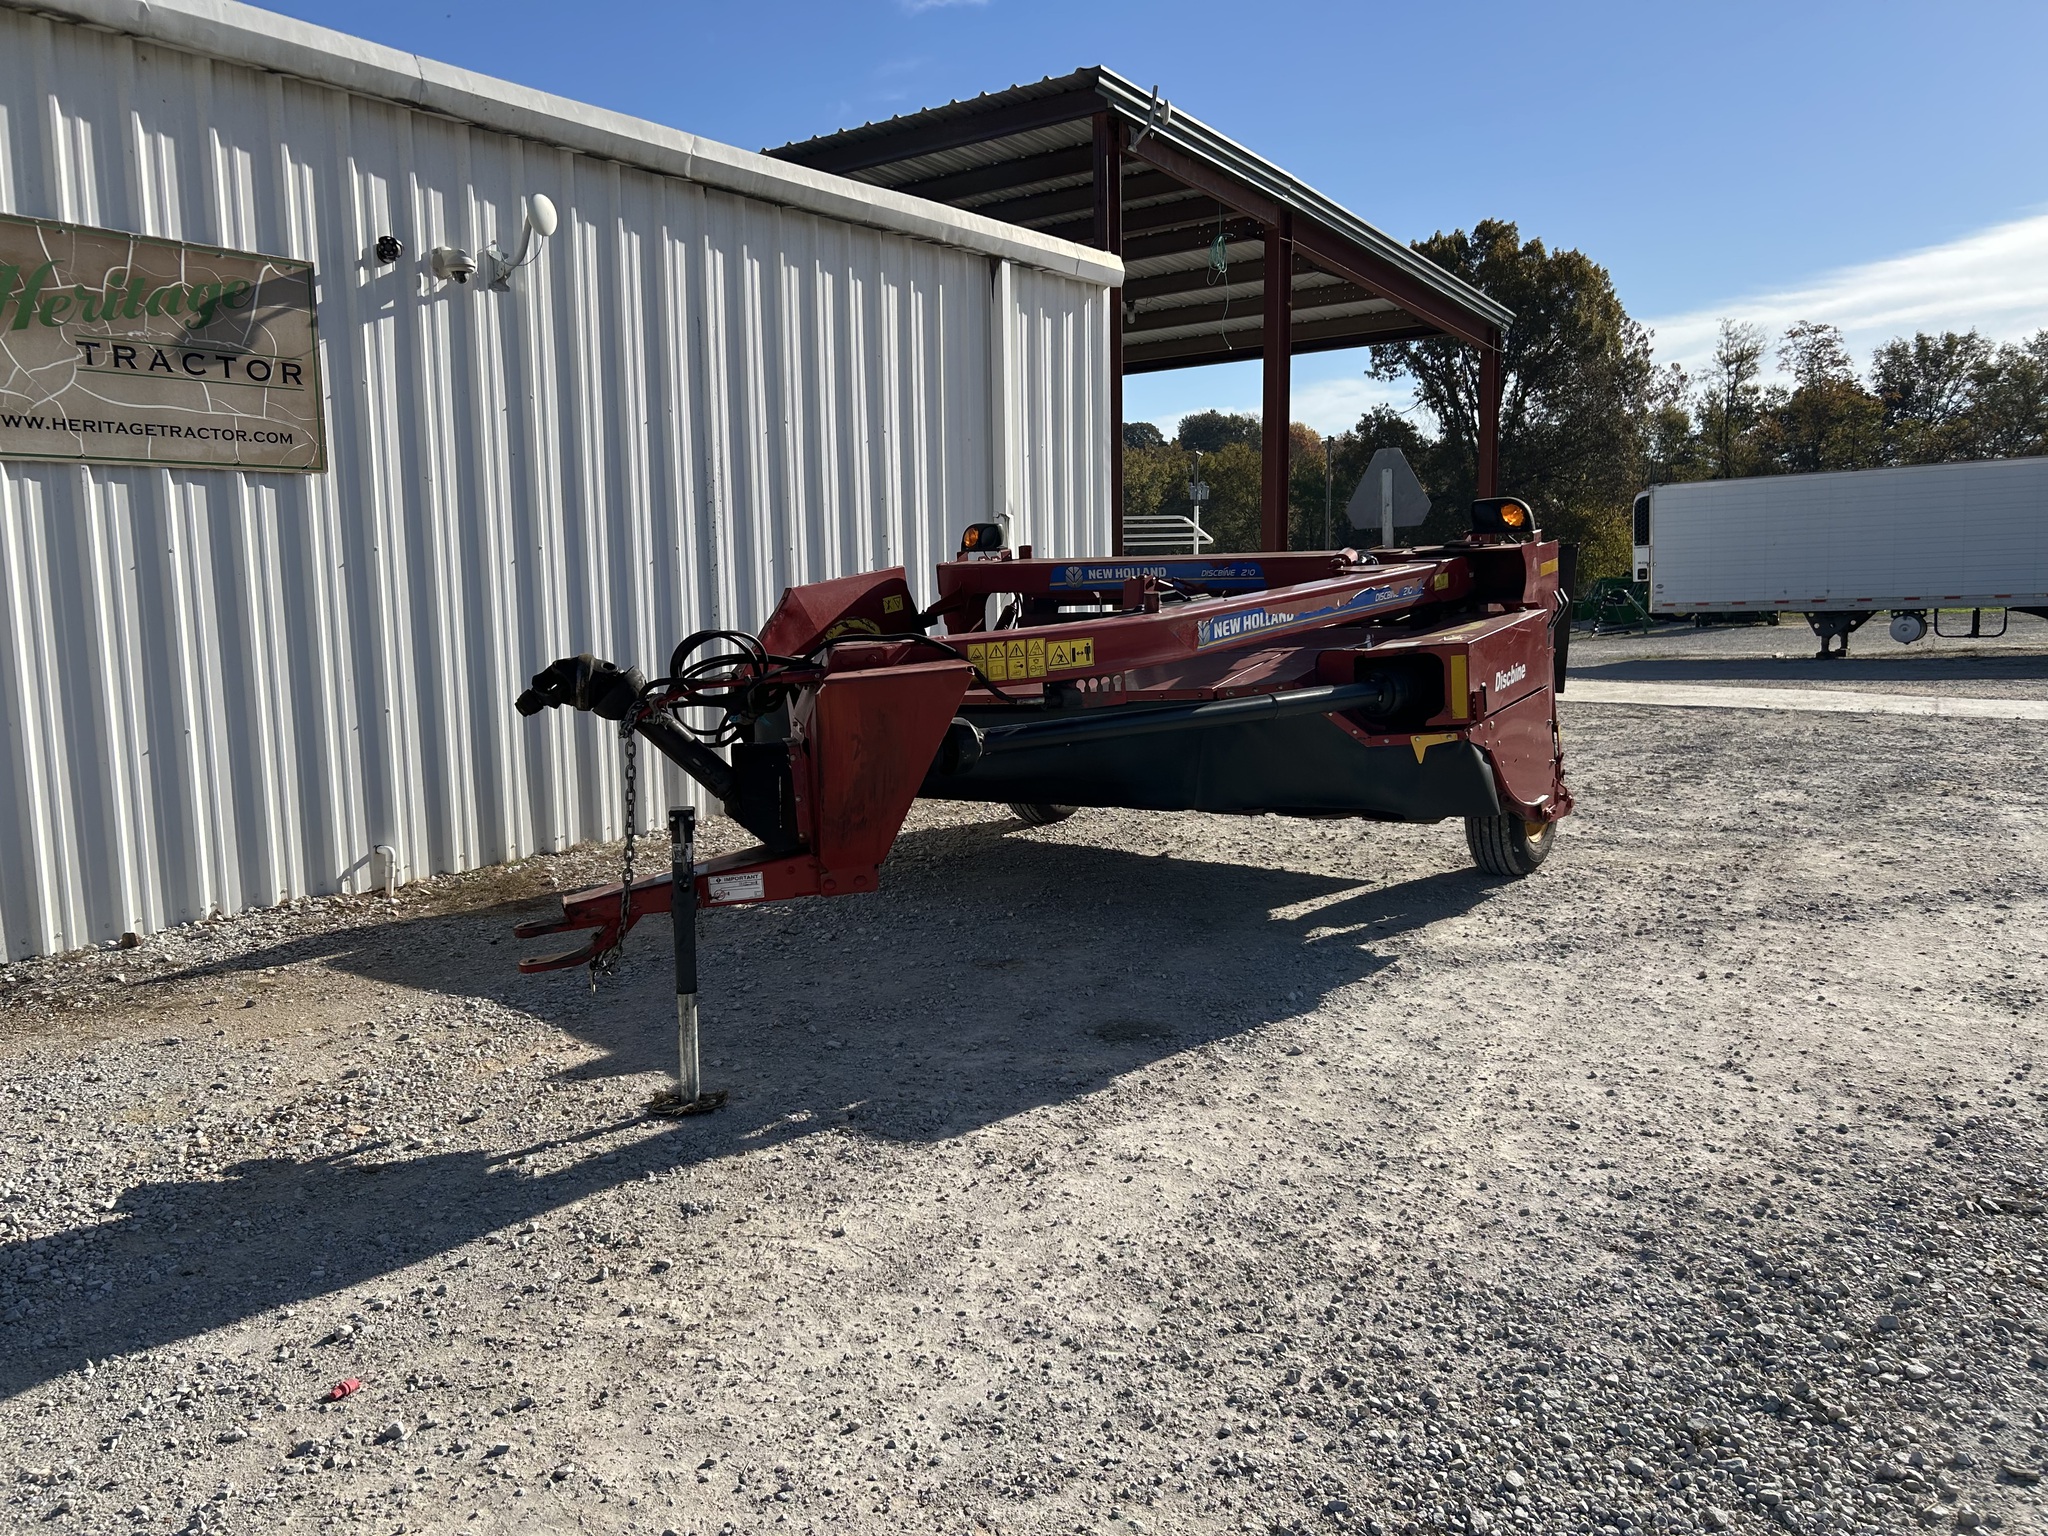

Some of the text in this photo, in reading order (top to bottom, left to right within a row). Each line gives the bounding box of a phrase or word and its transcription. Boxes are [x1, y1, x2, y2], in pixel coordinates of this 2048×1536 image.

[0, 259, 251, 331] Heritage
[75, 340, 304, 386] TRACTOR
[1089, 567, 1167, 579] NEW HOLLAND
[1214, 617, 1240, 638] NEW
[1495, 662, 1526, 692] Discbine
[724, 874, 758, 882] IMPORTANT
